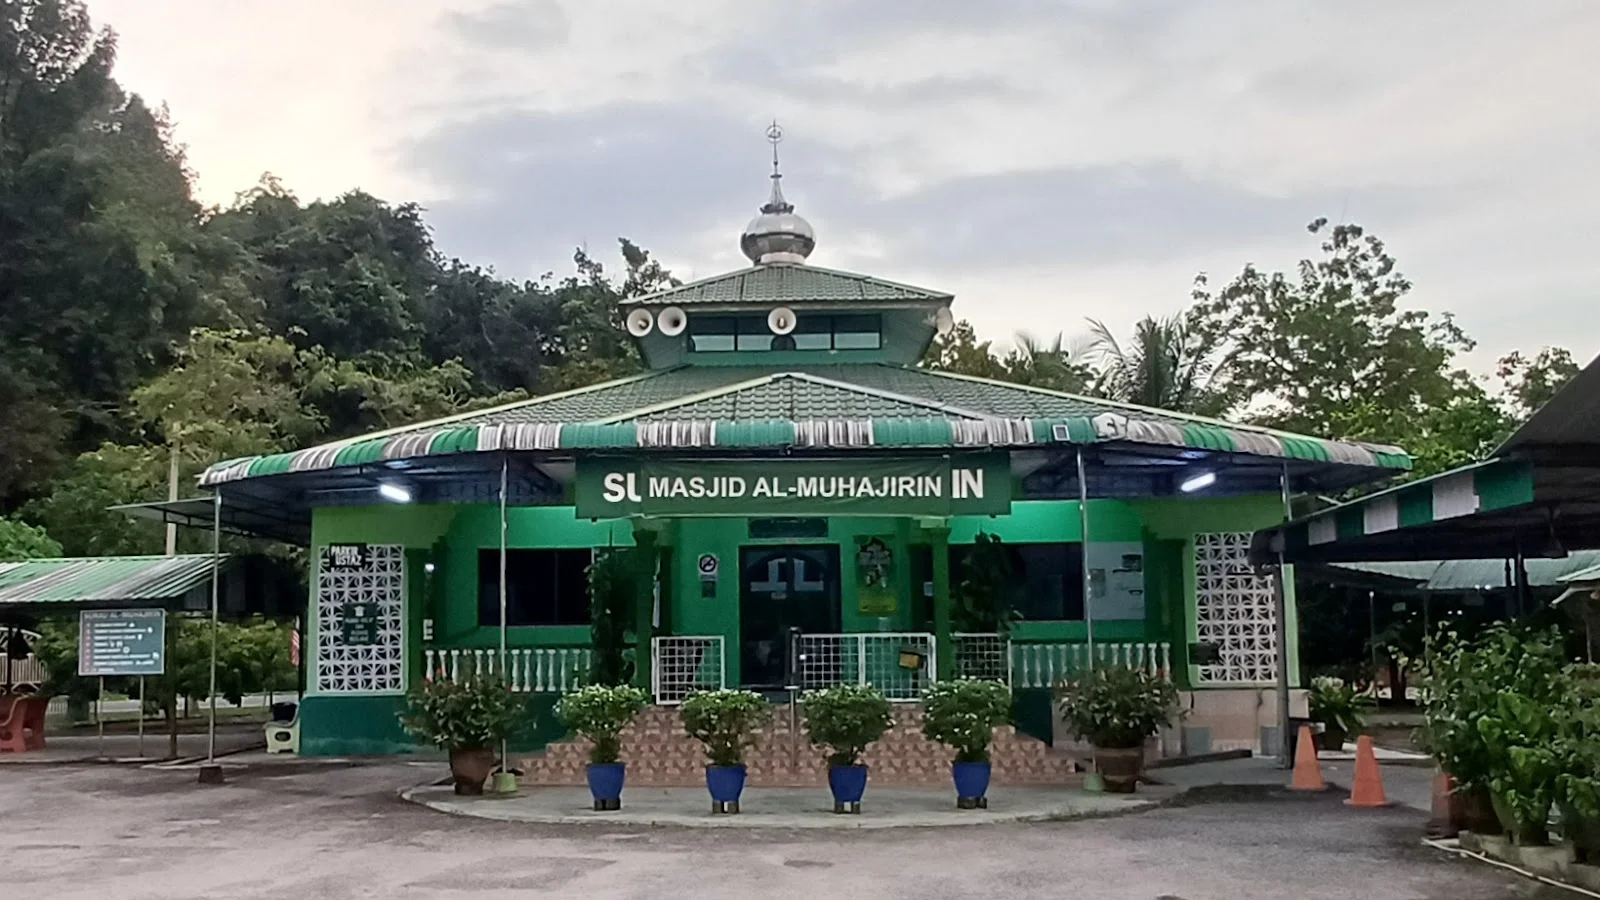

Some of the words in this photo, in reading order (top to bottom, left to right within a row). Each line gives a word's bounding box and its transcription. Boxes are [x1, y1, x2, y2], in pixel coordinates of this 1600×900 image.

[648, 476, 747, 498] MASJID
[752, 476, 942, 498] AL-MUHAJIRIN
[951, 468, 984, 499] IN
[335, 554, 363, 566] USTAZ
